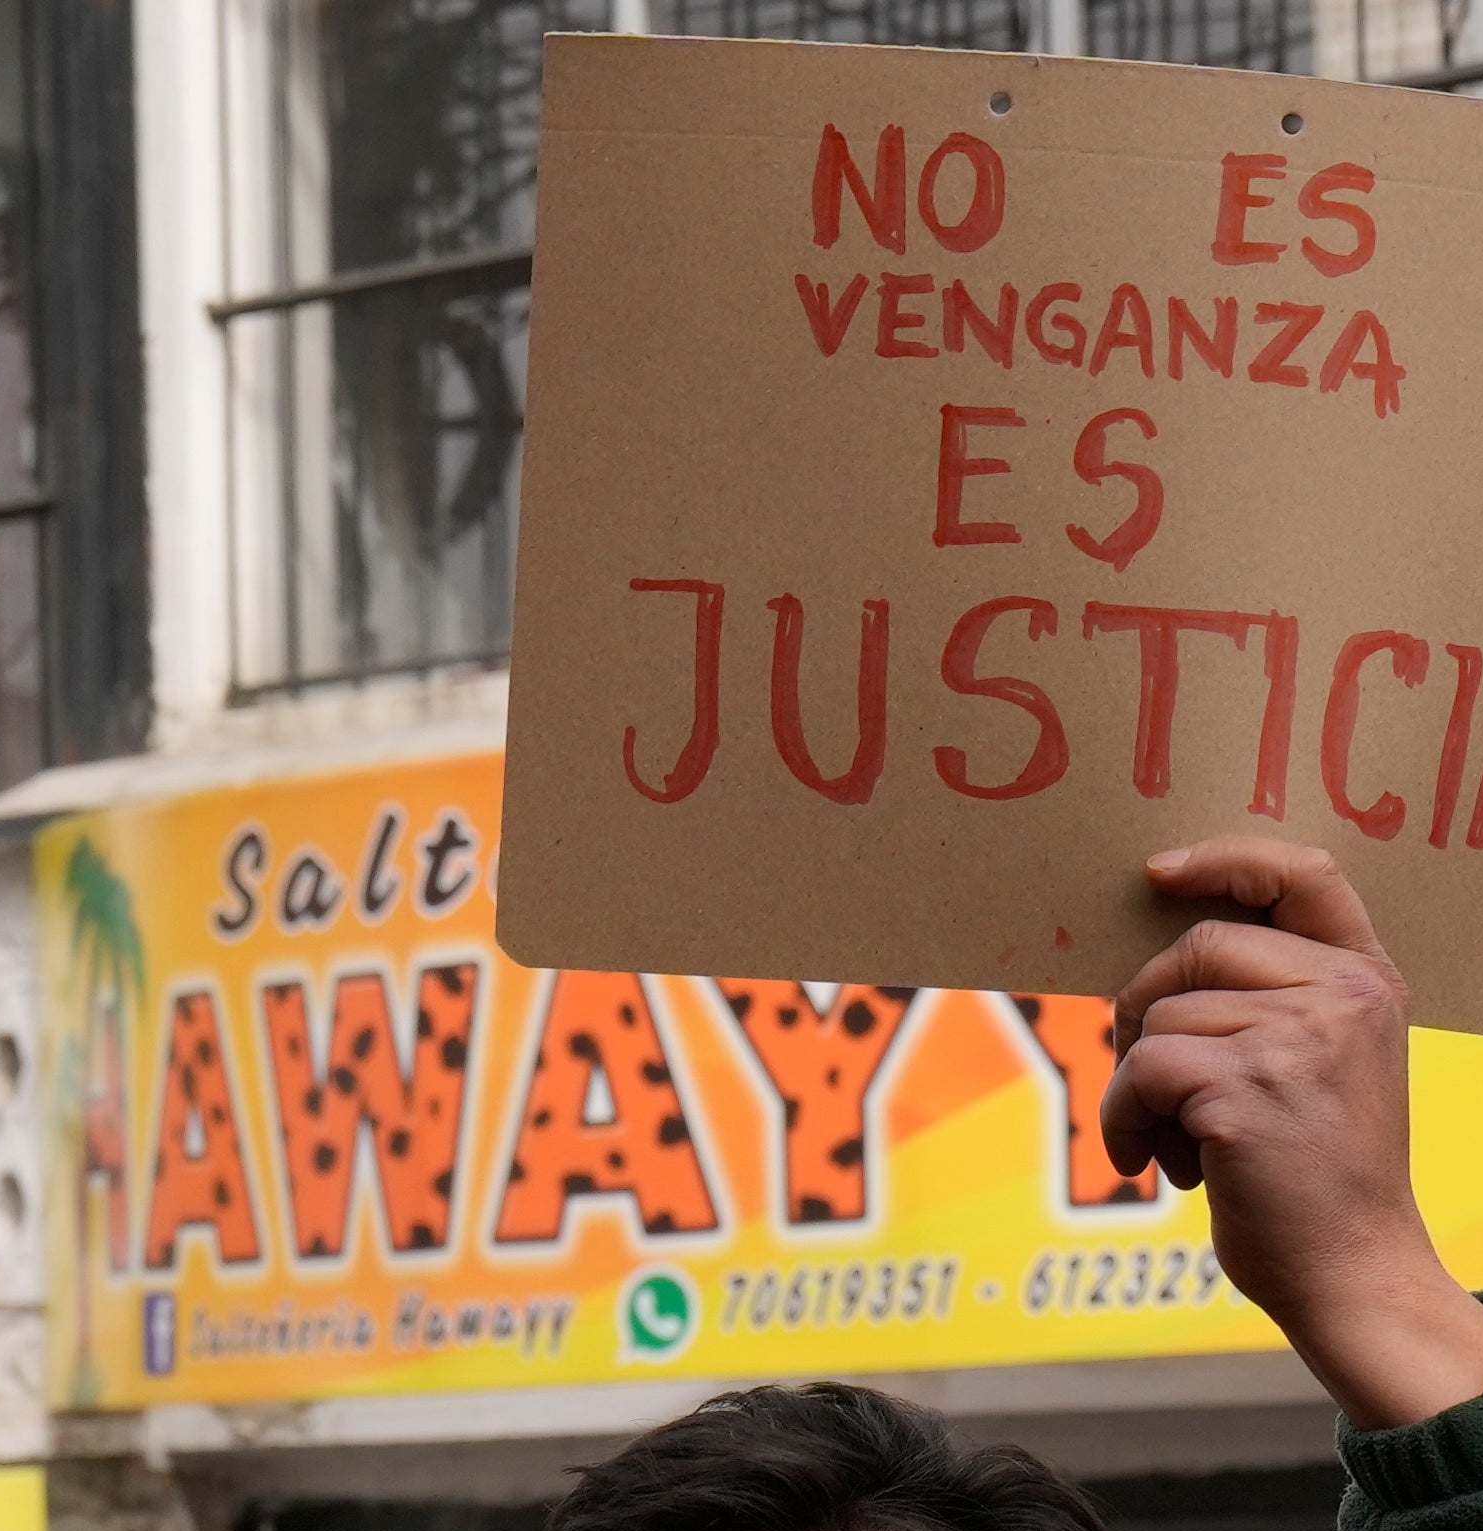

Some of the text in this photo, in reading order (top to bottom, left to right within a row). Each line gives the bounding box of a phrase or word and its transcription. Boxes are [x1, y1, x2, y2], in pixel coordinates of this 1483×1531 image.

[812, 124, 1377, 277] NO ES
[794, 273, 1406, 418] VENGANZA
[931, 404, 1165, 571] ES
[214, 808, 498, 934] Salt
[1026, 1246, 1243, 1310] 612329
